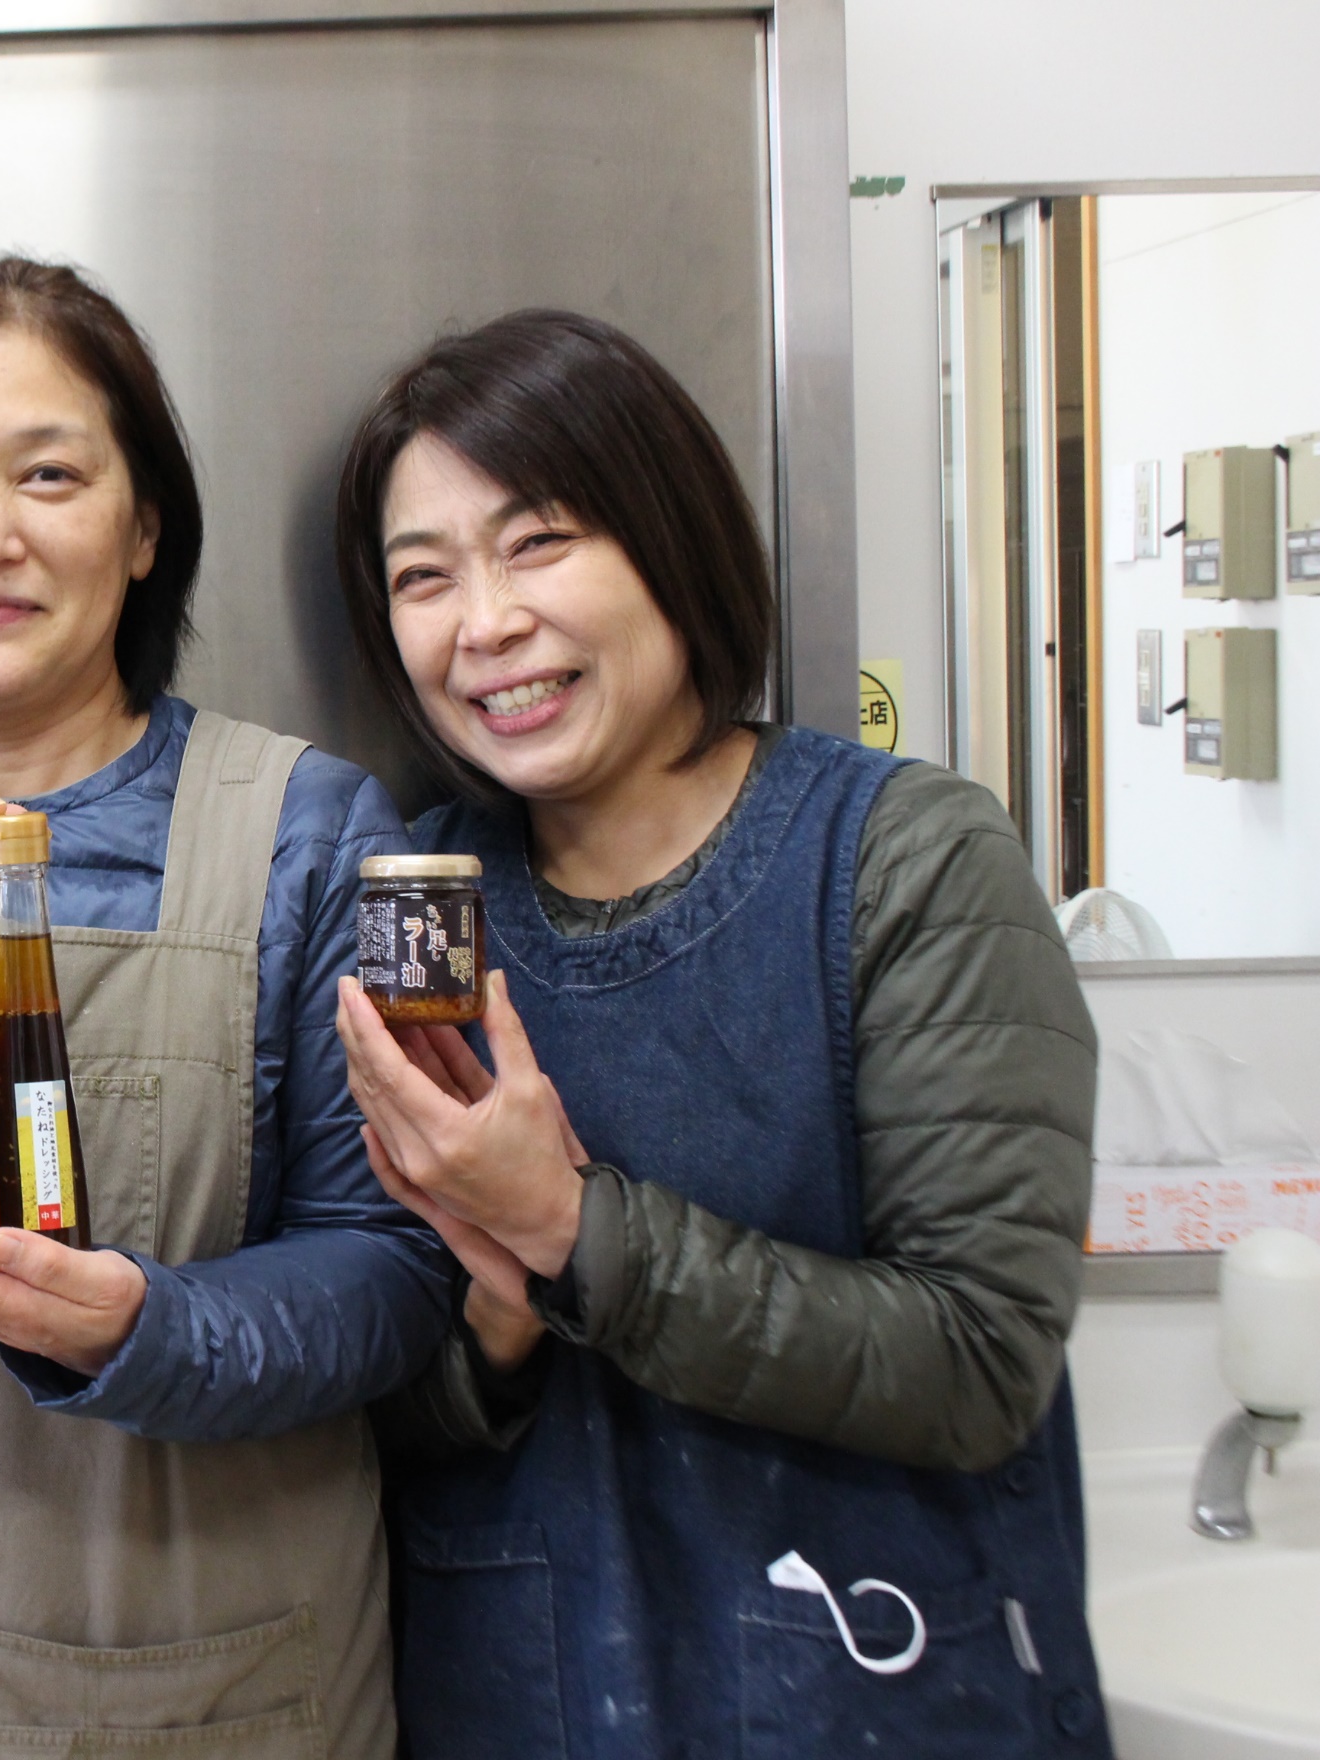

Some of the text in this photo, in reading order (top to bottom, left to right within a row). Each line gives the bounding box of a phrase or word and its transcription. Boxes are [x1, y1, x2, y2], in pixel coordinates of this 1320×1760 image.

[860, 700, 887, 725] 店
[401, 916, 426, 987] ラー油
[36, 1090, 52, 1201] なたねドレッシング
[41, 1210, 59, 1221] 中華
